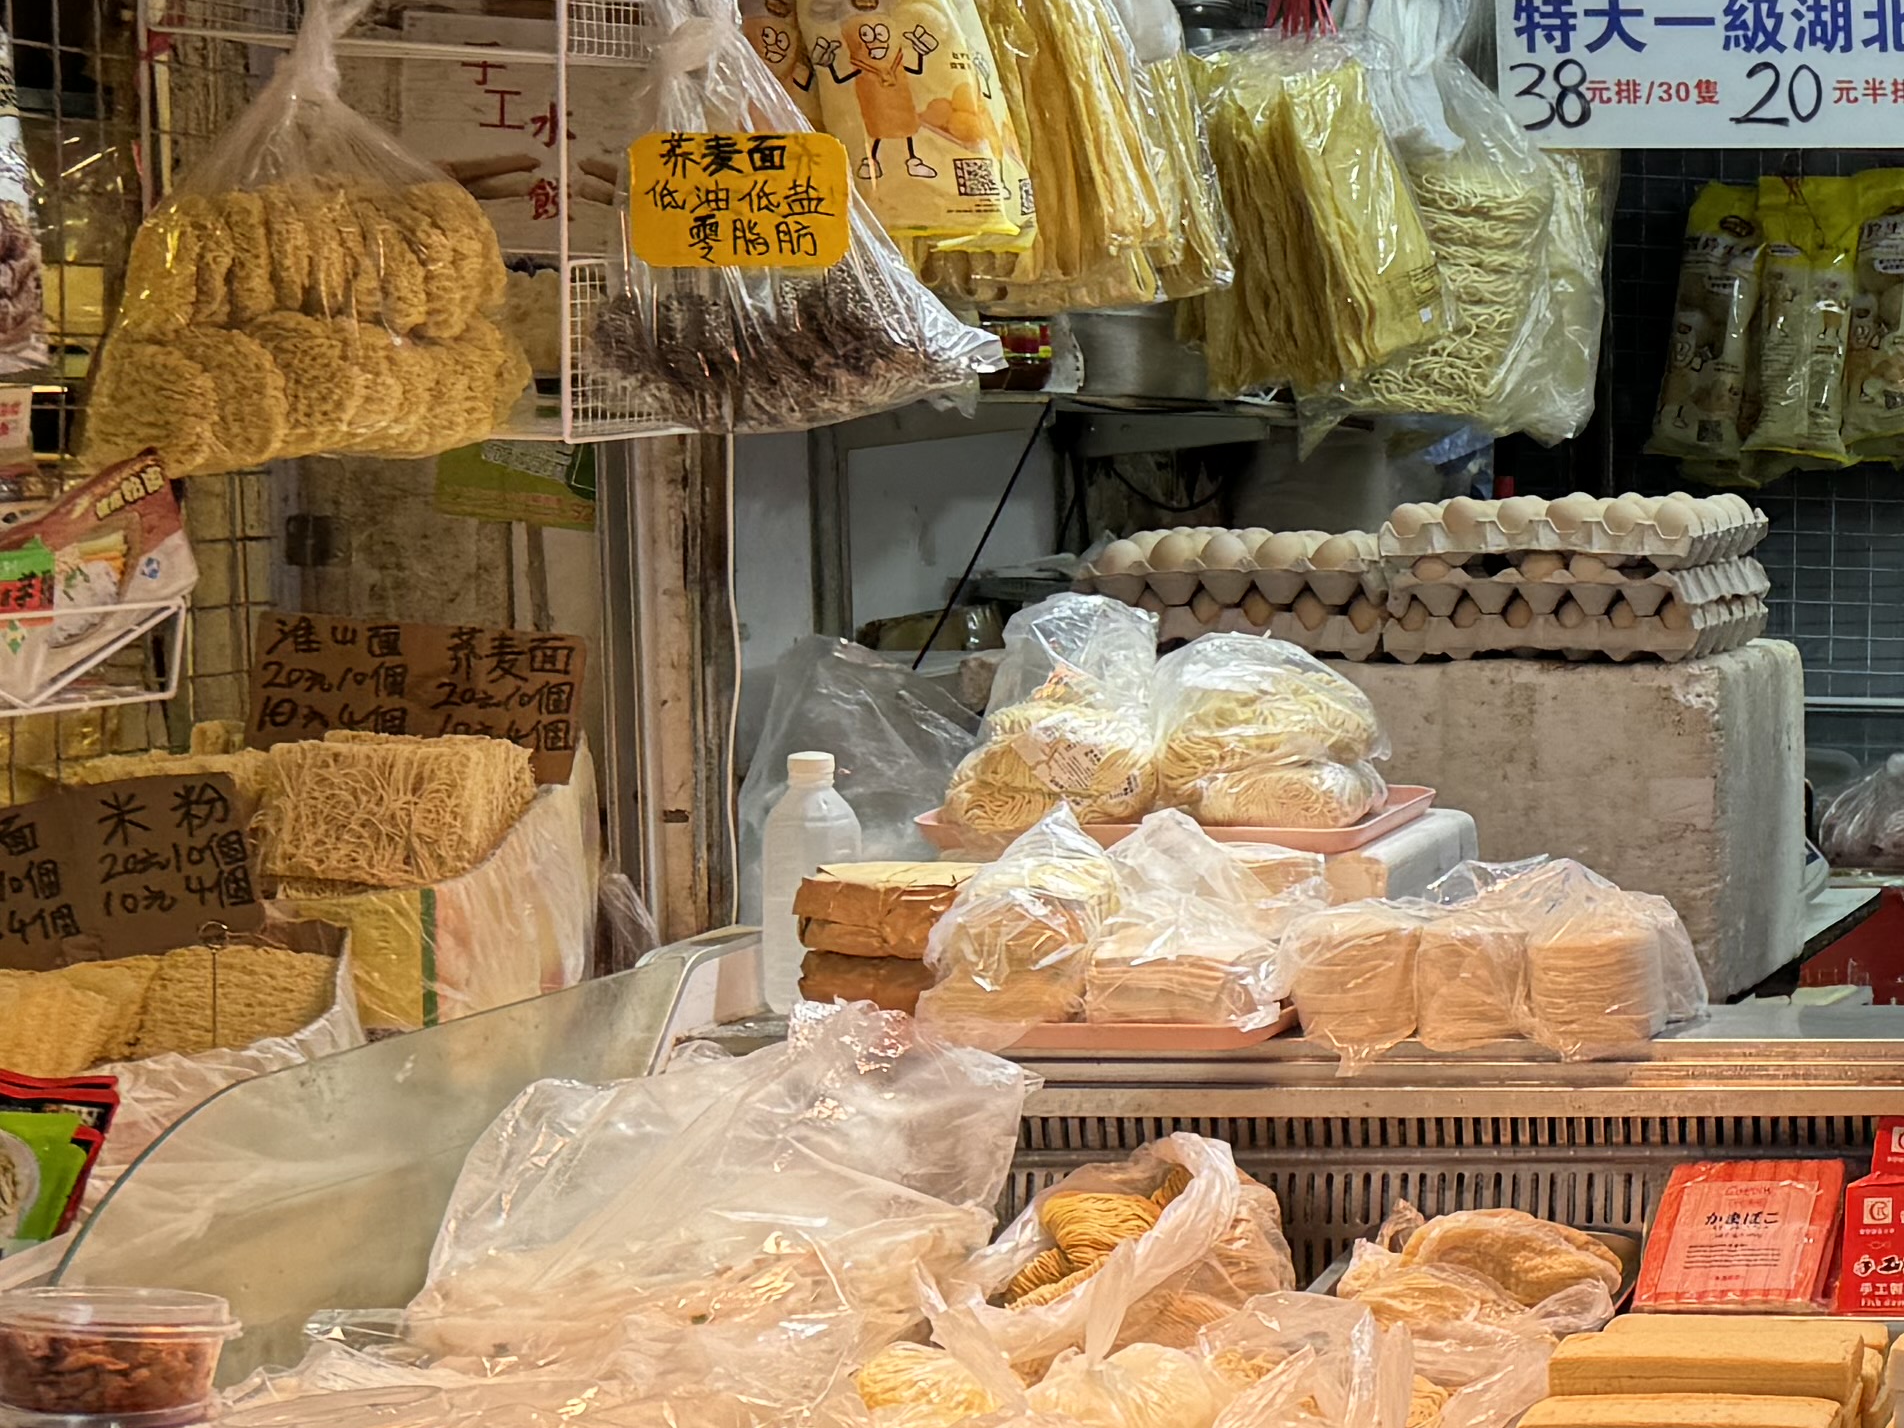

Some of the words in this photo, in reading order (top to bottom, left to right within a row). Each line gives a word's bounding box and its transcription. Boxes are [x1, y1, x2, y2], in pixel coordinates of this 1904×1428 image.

[1509, 59, 1592, 131] 38
[1586, 78, 1721, 106] 元排/30隻
[1729, 60, 1823, 128] 20
[645, 175, 835, 219] 低油低盐
[688, 214, 818, 264] 零脂肪
[98, 782, 230, 847] 米粉
